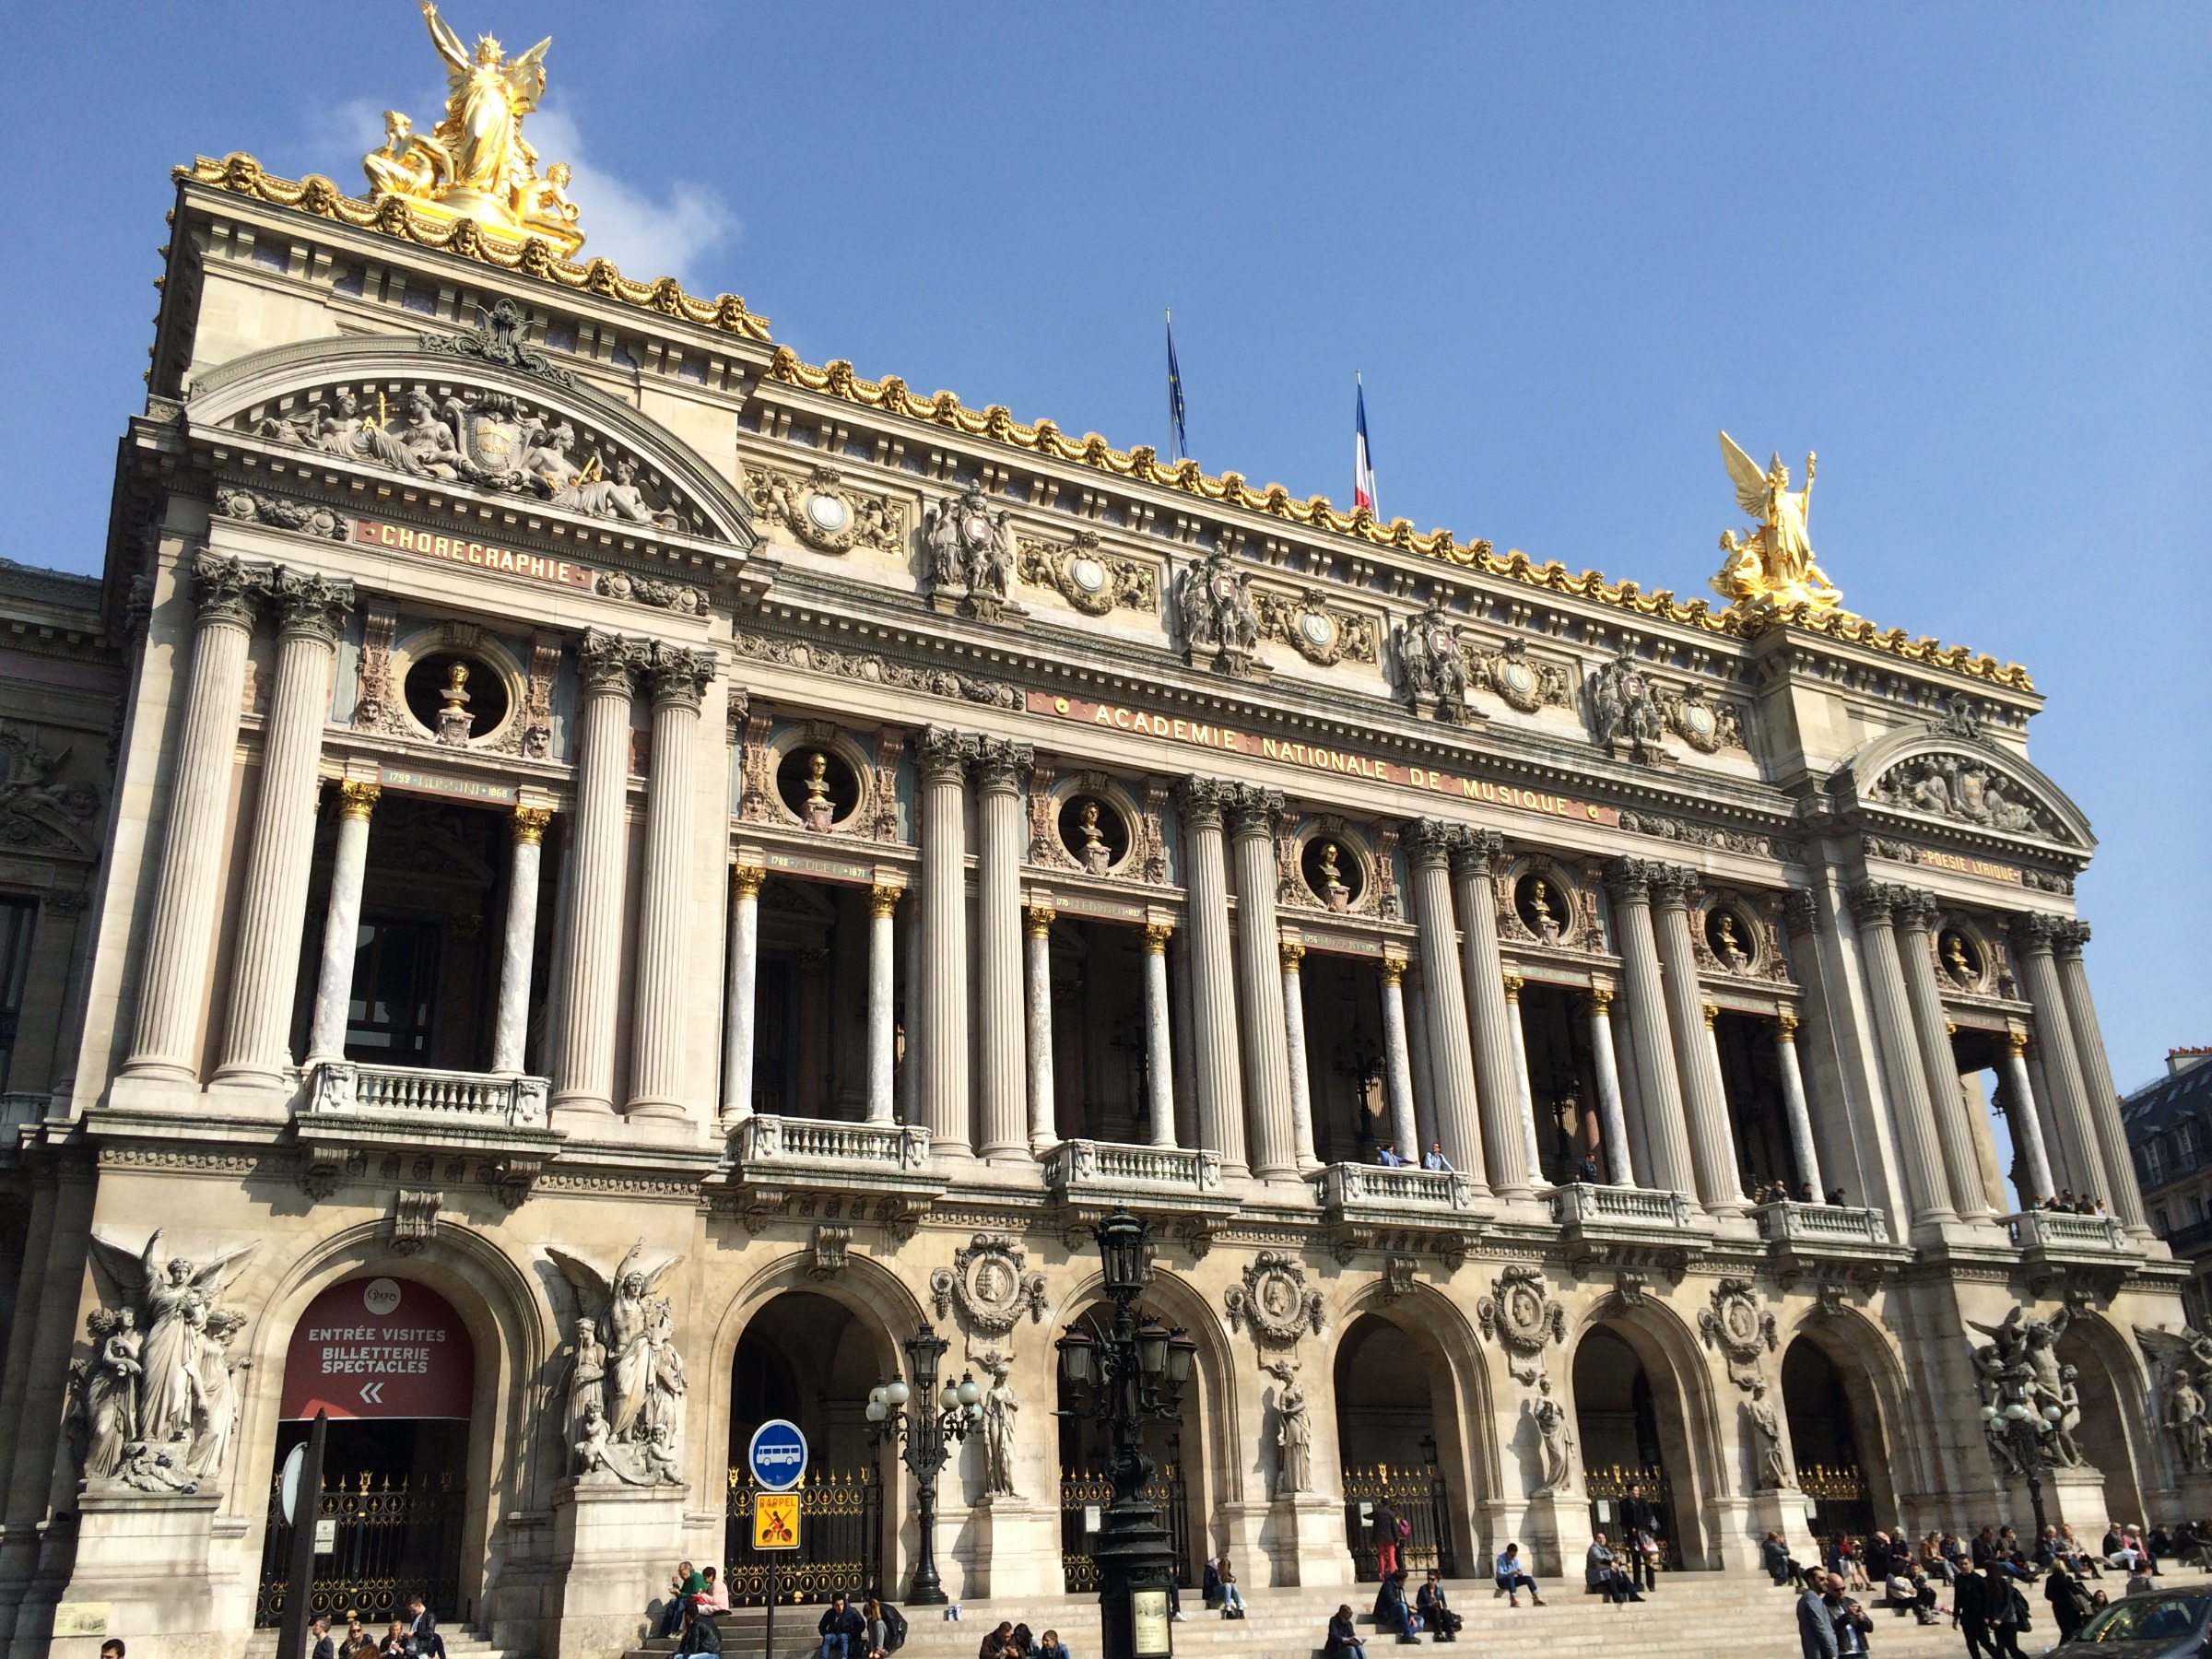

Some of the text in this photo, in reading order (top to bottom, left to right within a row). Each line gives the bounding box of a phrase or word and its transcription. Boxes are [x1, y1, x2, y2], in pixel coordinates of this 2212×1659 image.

[972, 519, 985, 538] E
[381, 524, 571, 582] CHOREGRAPHIE
[1220, 580, 1231, 596] E
[1310, 618, 1324, 638] N
[1436, 635, 1447, 651] E
[1512, 665, 1526, 686] N
[1629, 681, 1640, 696] E
[1094, 704, 1570, 817] ACADEMIE NATIONALE DE MUSIQUE
[389, 771, 411, 784] 1792
[488, 787, 508, 798] 1868
[849, 867, 865, 877] 1871
[1926, 851, 2017, 881] POESIE LYRIQUE
[309, 1324, 446, 1343] ENTRÉE VISITES
[323, 1347, 430, 1360] BILLETTERIE
[322, 1360, 428, 1374] SPECTACLES
[759, 1498, 795, 1508] RAPPEL
